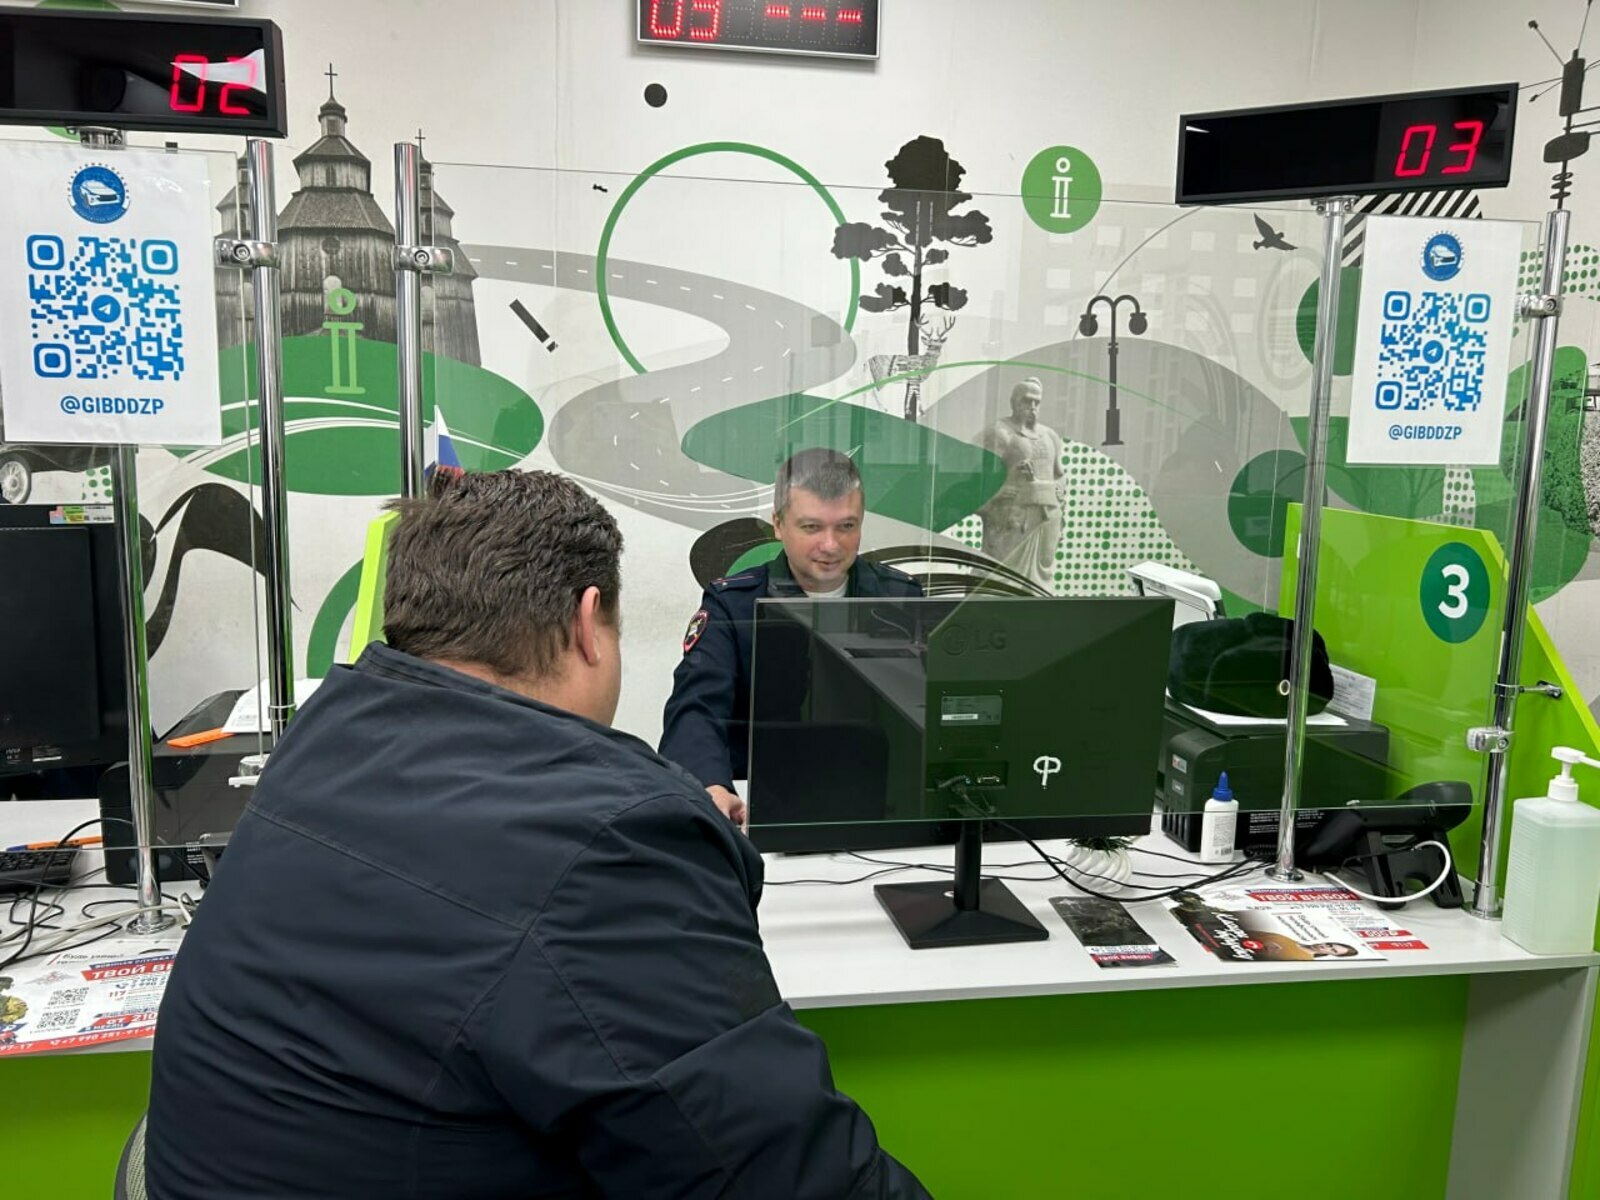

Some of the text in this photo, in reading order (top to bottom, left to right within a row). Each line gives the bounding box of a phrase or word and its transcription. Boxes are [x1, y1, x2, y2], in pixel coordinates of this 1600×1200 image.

[169, 54, 257, 116] 02
[1394, 121, 1484, 177] 03
[60, 395, 164, 415] @GIBDDZP
[1388, 424, 1463, 441] @GIBDDZP
[1438, 563, 1470, 619] 3
[974, 630, 1006, 650] LG
[92, 965, 146, 980] ТВОЙ
